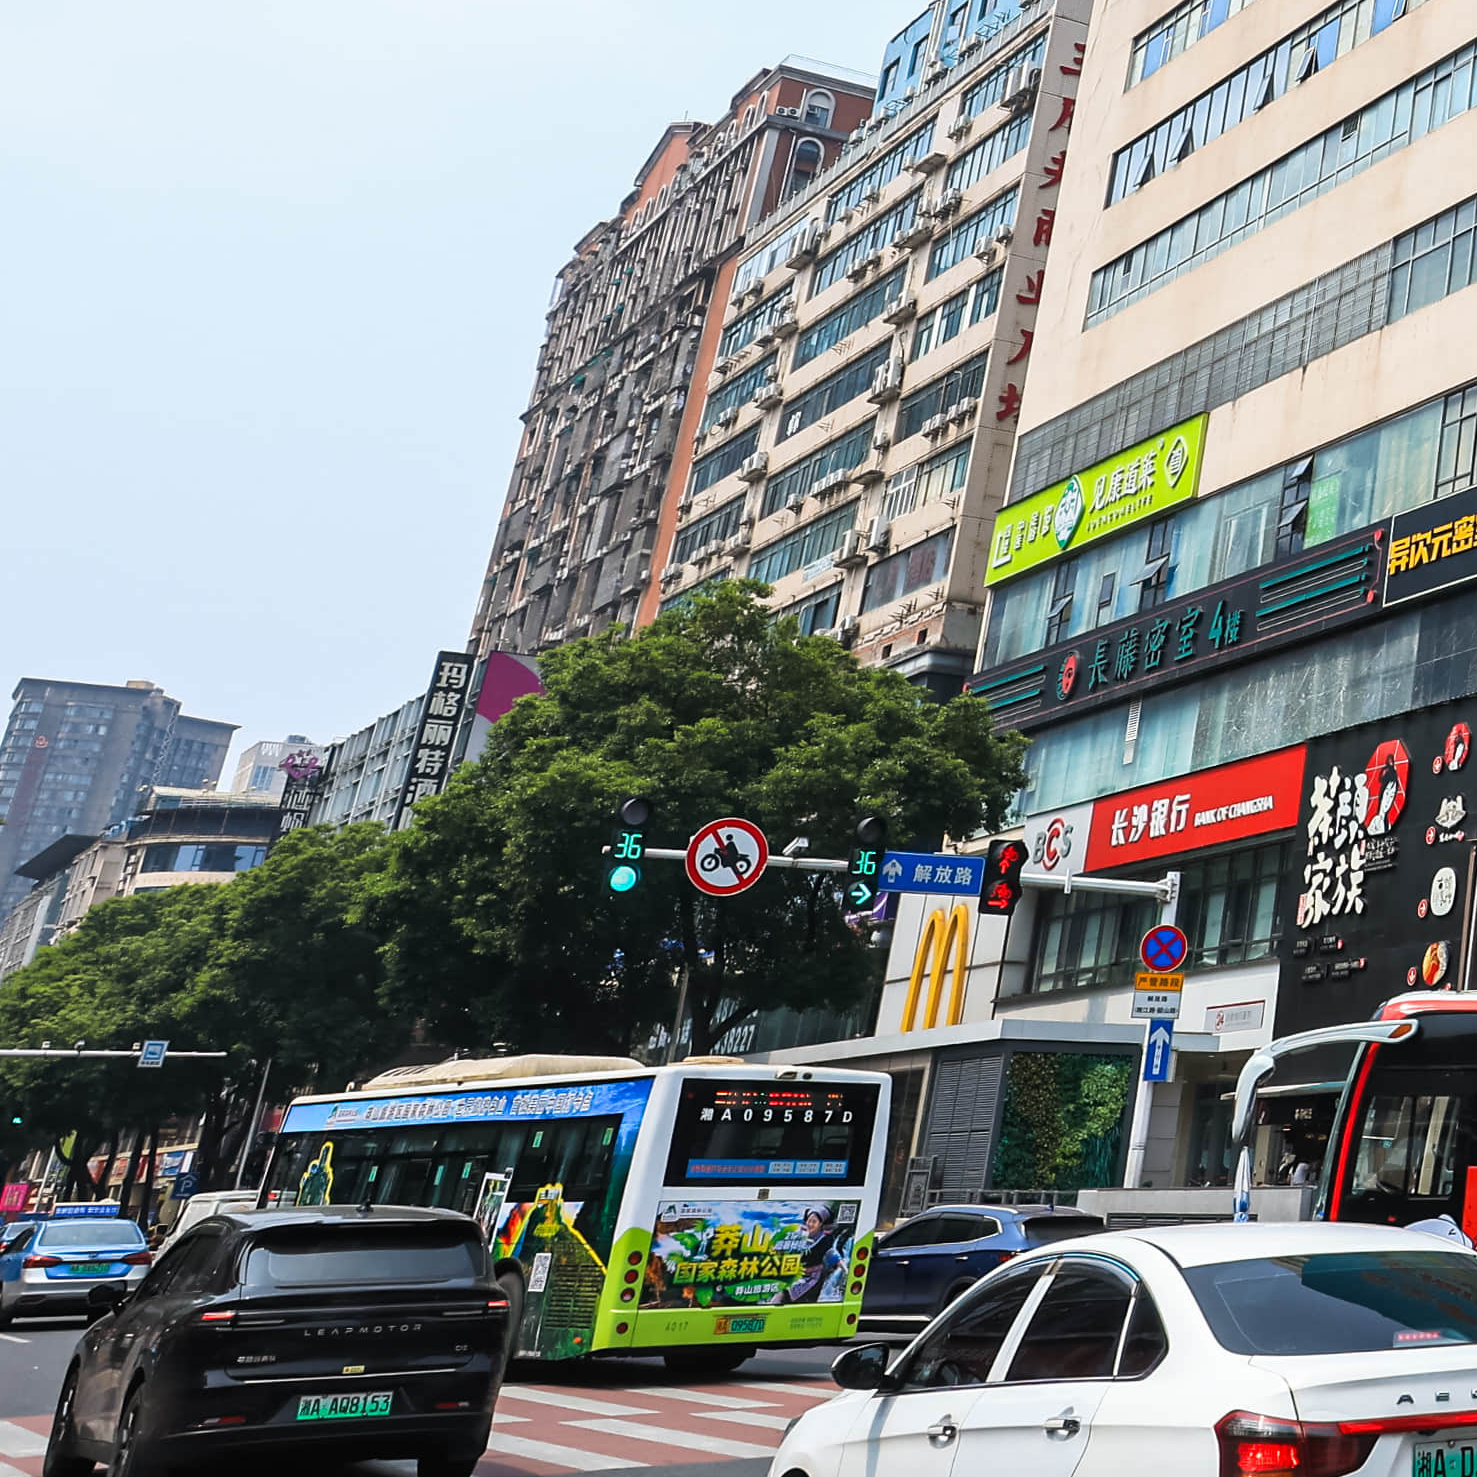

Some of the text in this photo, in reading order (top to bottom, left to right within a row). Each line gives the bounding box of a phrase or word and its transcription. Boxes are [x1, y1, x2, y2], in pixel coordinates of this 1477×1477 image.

[1111, 794, 1191, 847] 长沙银行
[1194, 811, 1216, 827] BANK
[614, 833, 642, 860] 36
[1032, 818, 1073, 870] BCS
[855, 850, 876, 876] 36
[913, 862, 973, 886] 解放路
[1137, 976, 1180, 987] 严管路段
[712, 1224, 770, 1256] 莽山
[673, 1254, 801, 1284] 国家森林公园
[304, 1324, 424, 1336] LEAPMOTOR
